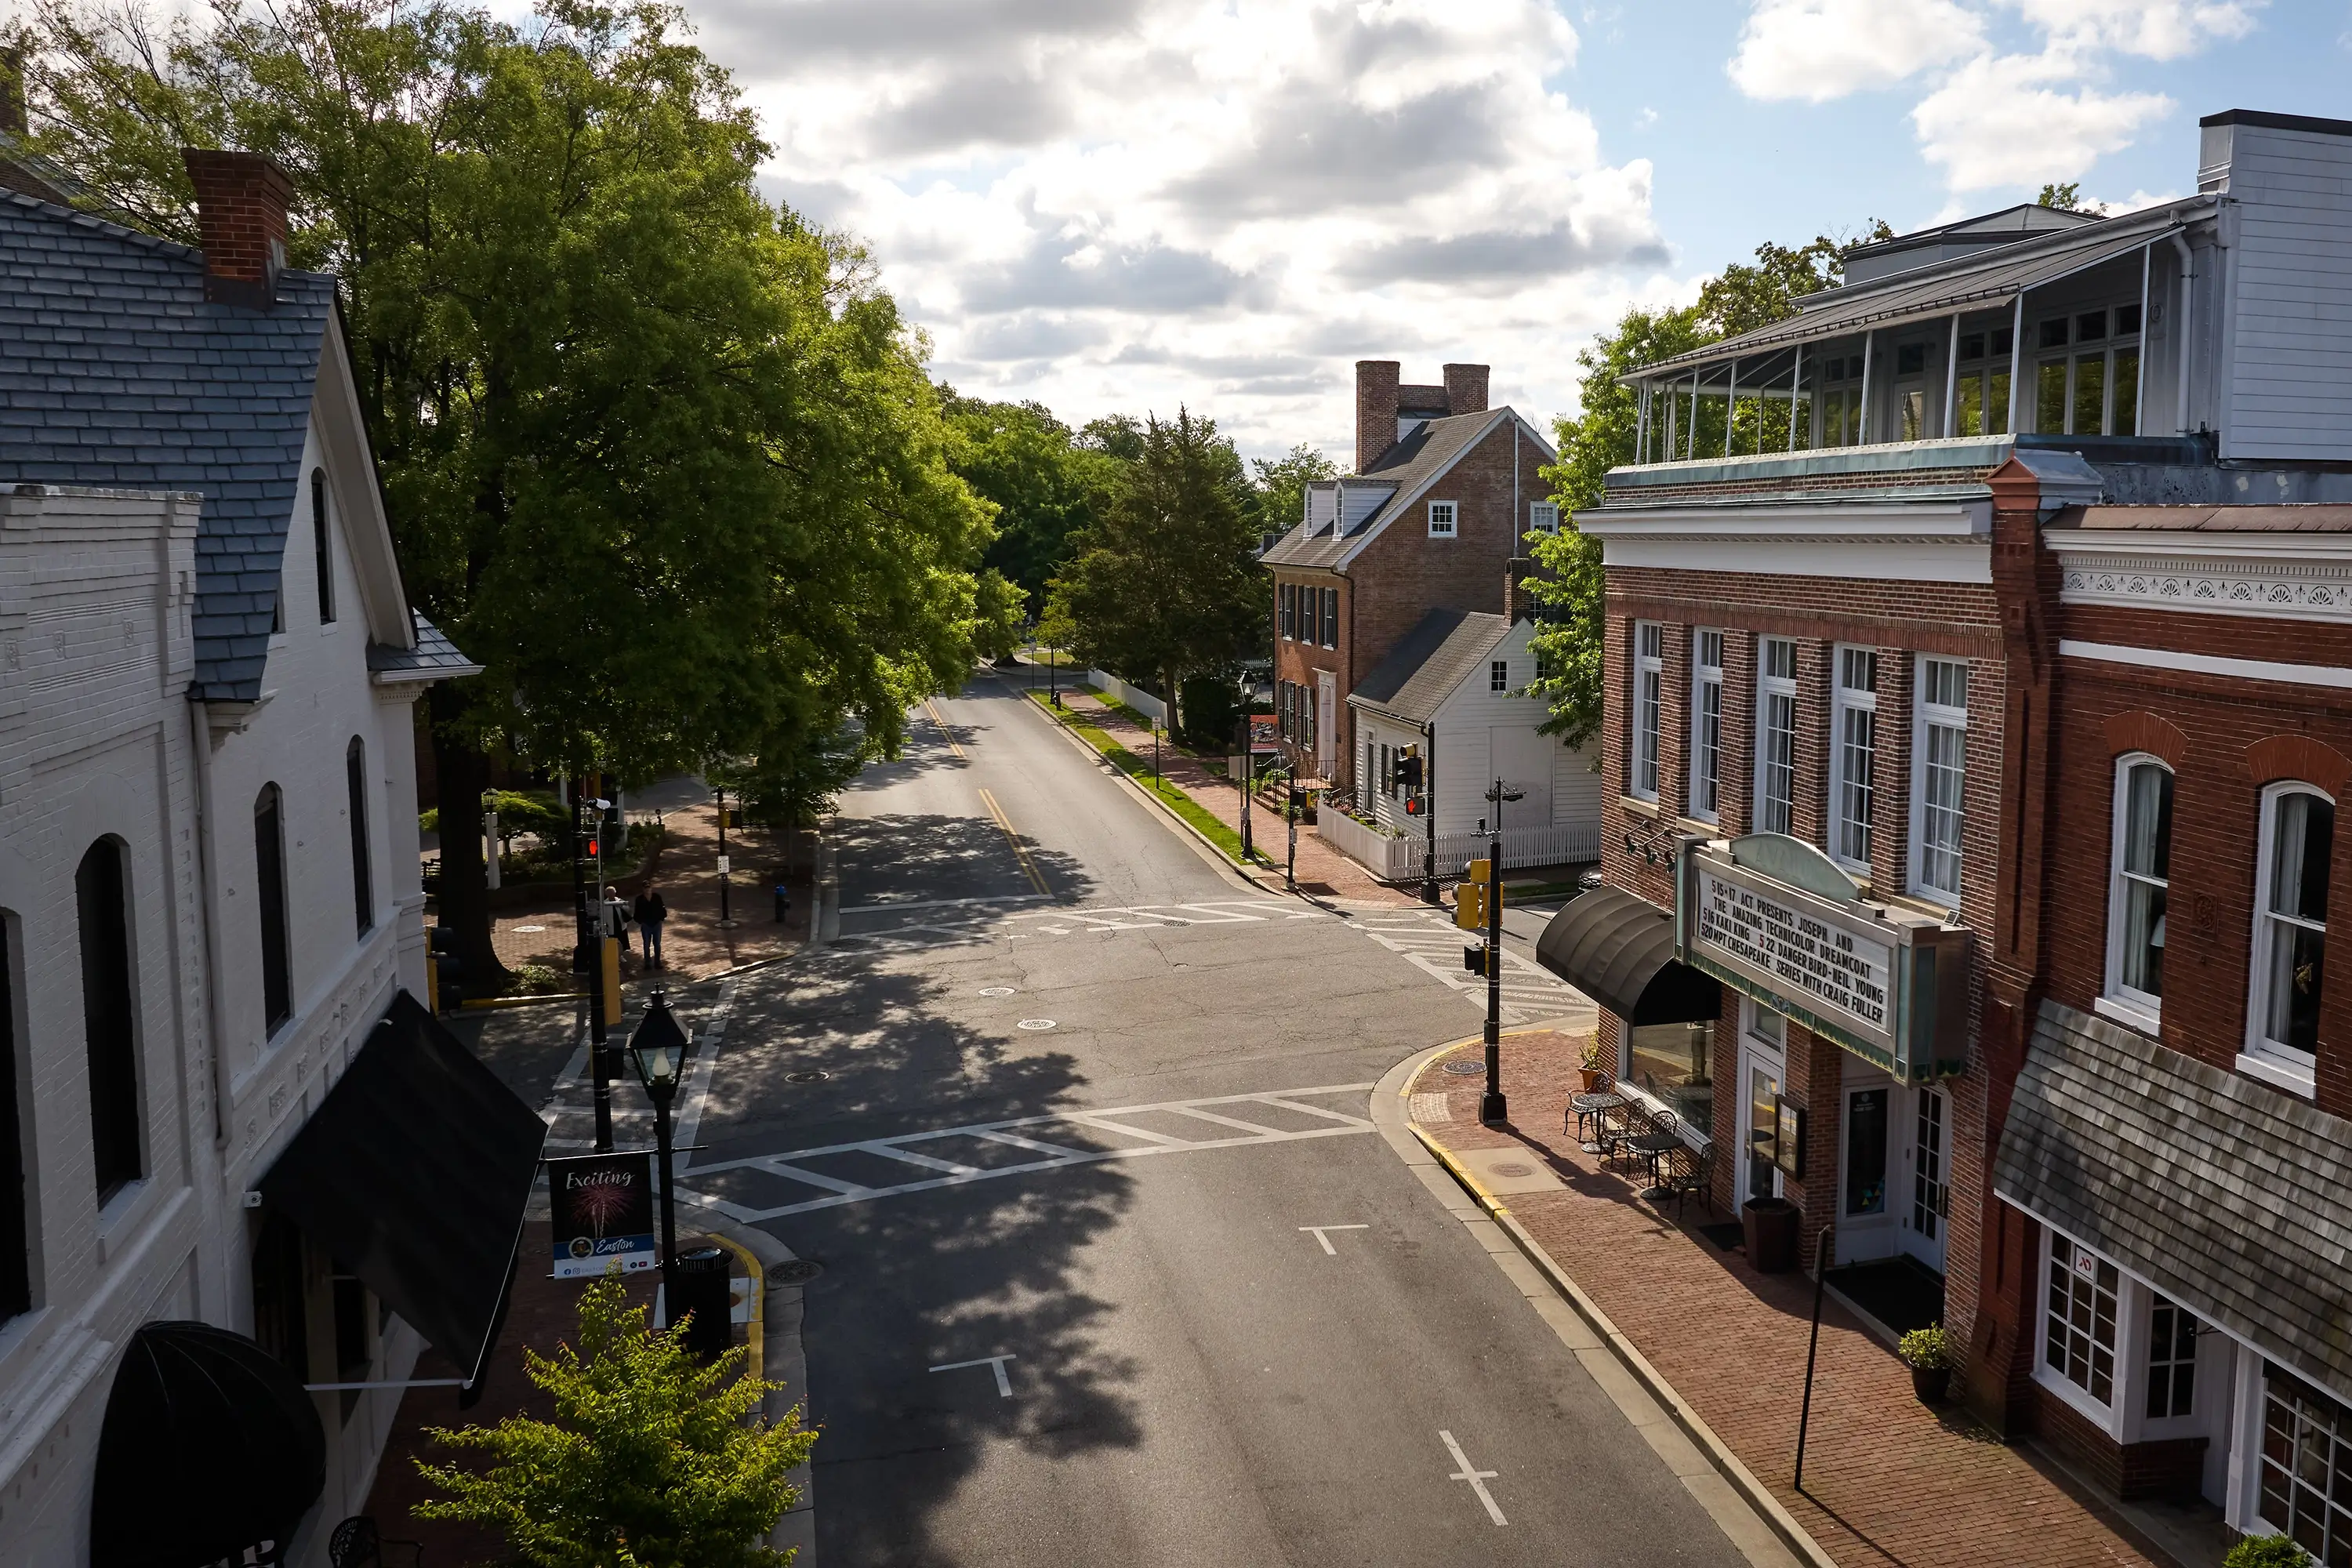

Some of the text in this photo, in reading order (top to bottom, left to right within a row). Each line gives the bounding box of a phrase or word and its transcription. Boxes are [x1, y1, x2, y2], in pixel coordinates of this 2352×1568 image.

[1714, 897, 1871, 979] THE AMAZING TECHNICOLOR DREAMCOAT
[1716, 913, 1731, 933] KAKI
[1734, 924, 1749, 941] KING
[1855, 978, 1882, 1004] YOUNG
[1740, 893, 1753, 909] ACT
[1757, 899, 1792, 926] PRESENTS
[1798, 917, 1827, 942] JOSEPH
[1836, 933, 1853, 953] AND
[1728, 937, 1770, 968] CHESAPEAKE
[1777, 960, 1801, 983] SERIES
[1803, 972, 1822, 994] WITH
[1824, 983, 1849, 1007] CRAIG
[1852, 996, 1882, 1024] FULLER
[566, 1171, 635, 1190] Exciting
[596, 1238, 635, 1254] Easton
